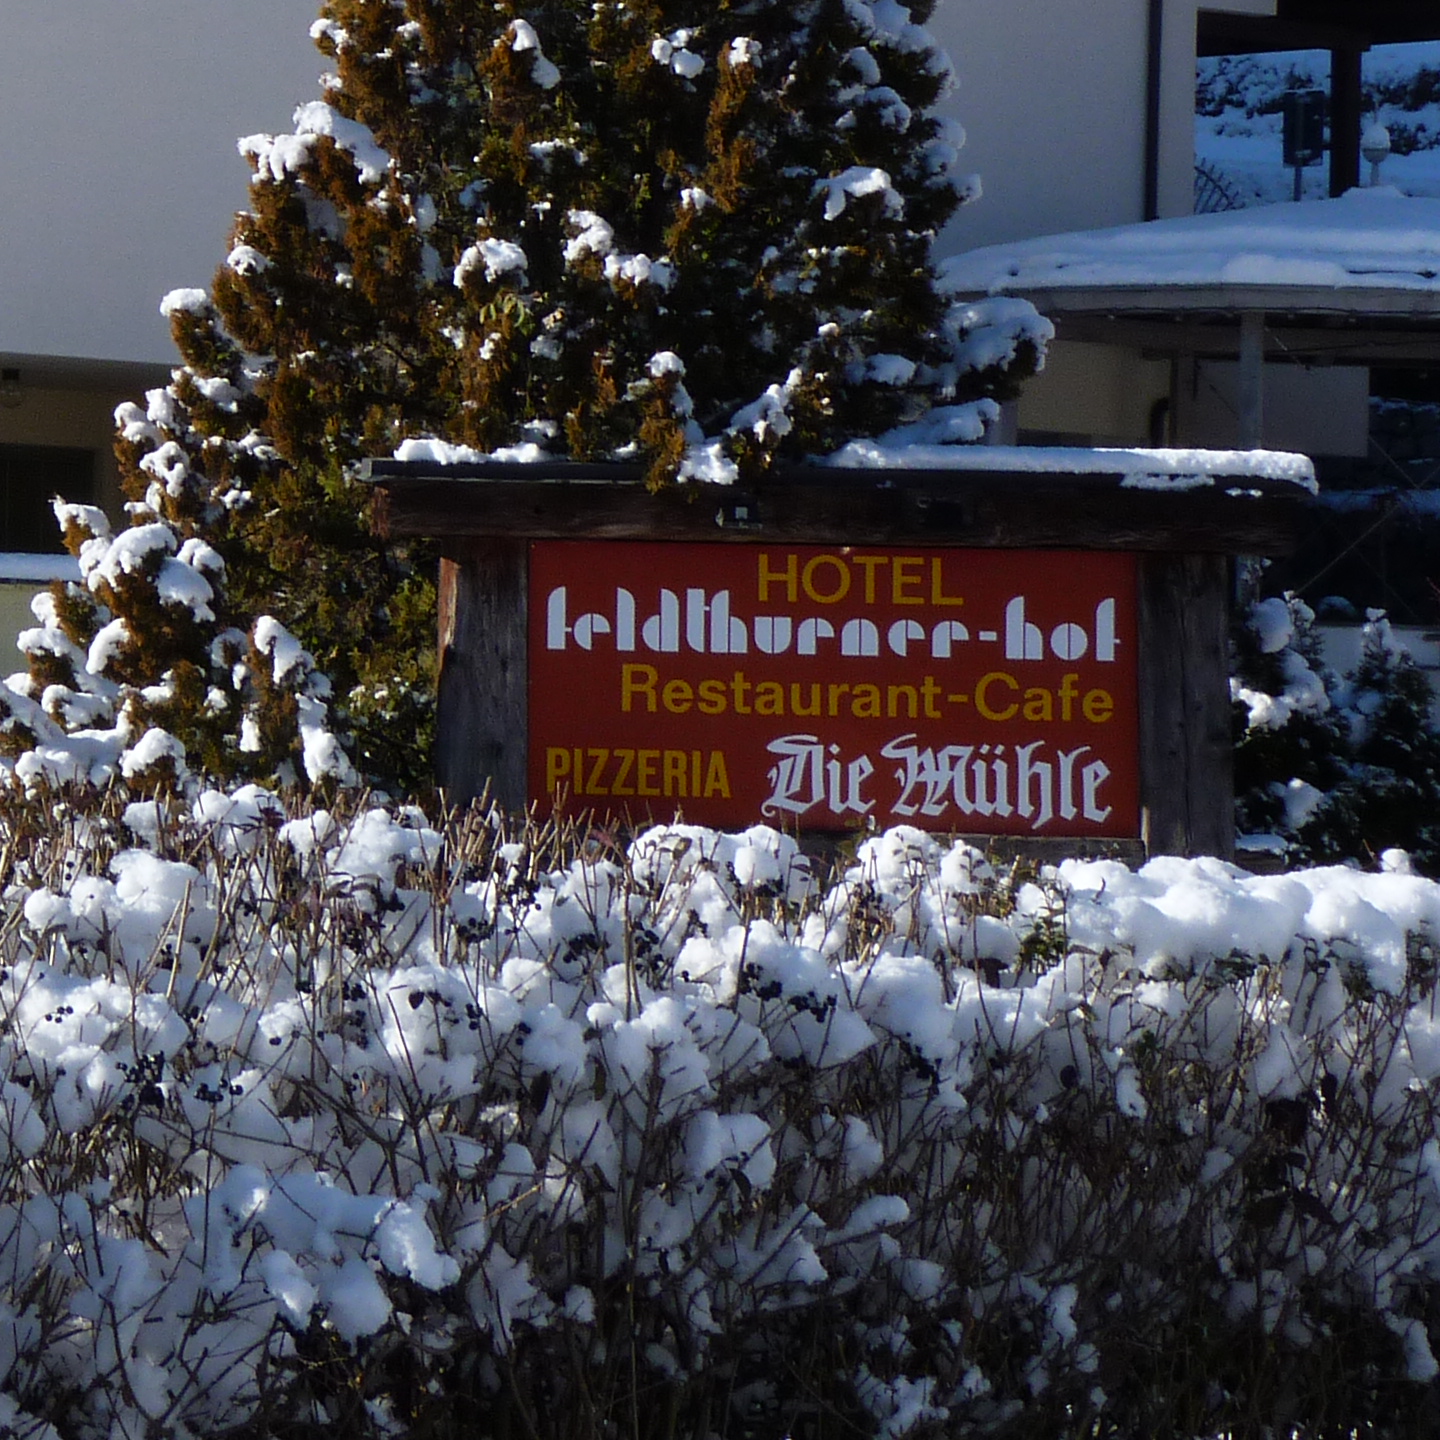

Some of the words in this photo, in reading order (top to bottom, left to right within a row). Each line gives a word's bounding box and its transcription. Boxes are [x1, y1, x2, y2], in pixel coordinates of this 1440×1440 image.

[757, 553, 964, 606] HOTEL
[621, 662, 1114, 724] Restaurant-Cafe
[545, 746, 732, 799] PIZZERIA
[761, 733, 876, 817] Die
[880, 732, 1113, 830] Mühle
